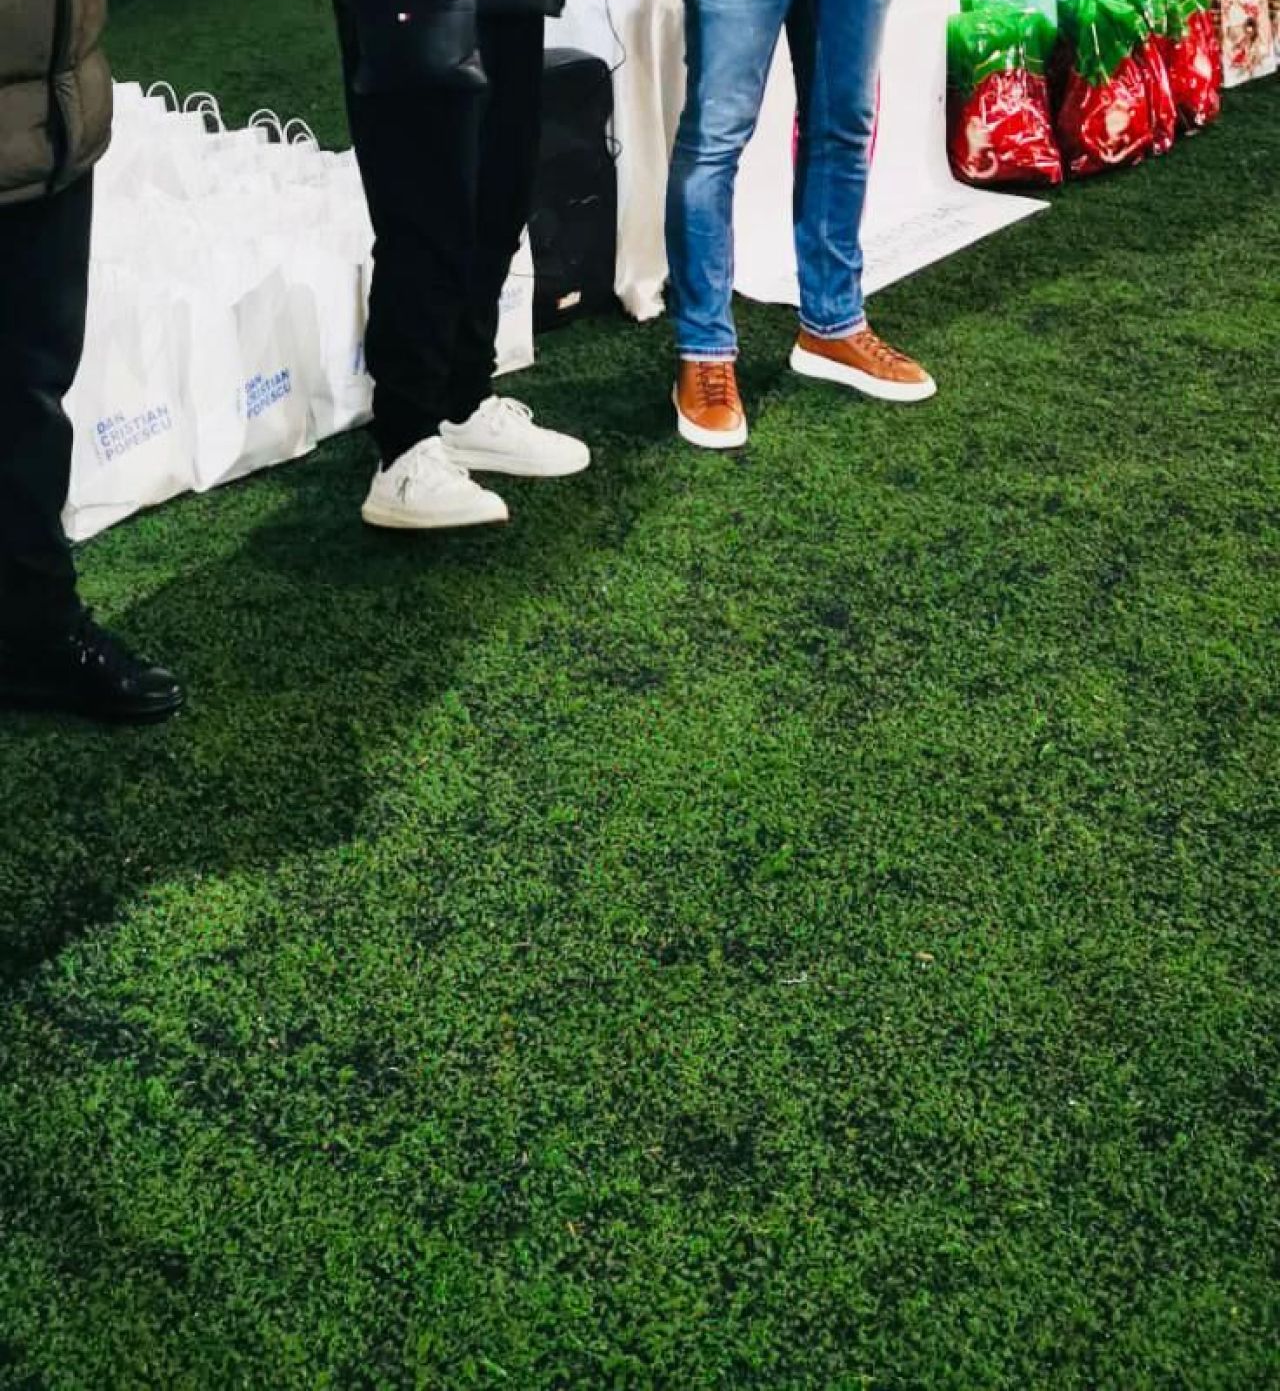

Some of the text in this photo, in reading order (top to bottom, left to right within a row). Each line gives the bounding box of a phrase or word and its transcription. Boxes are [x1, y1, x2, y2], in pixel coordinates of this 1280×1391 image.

[247, 382, 291, 419] POPESCU
[97, 411, 125, 435] DAN
[101, 406, 168, 447] CRISTIAN
[106, 416, 171, 461] POPESCU
